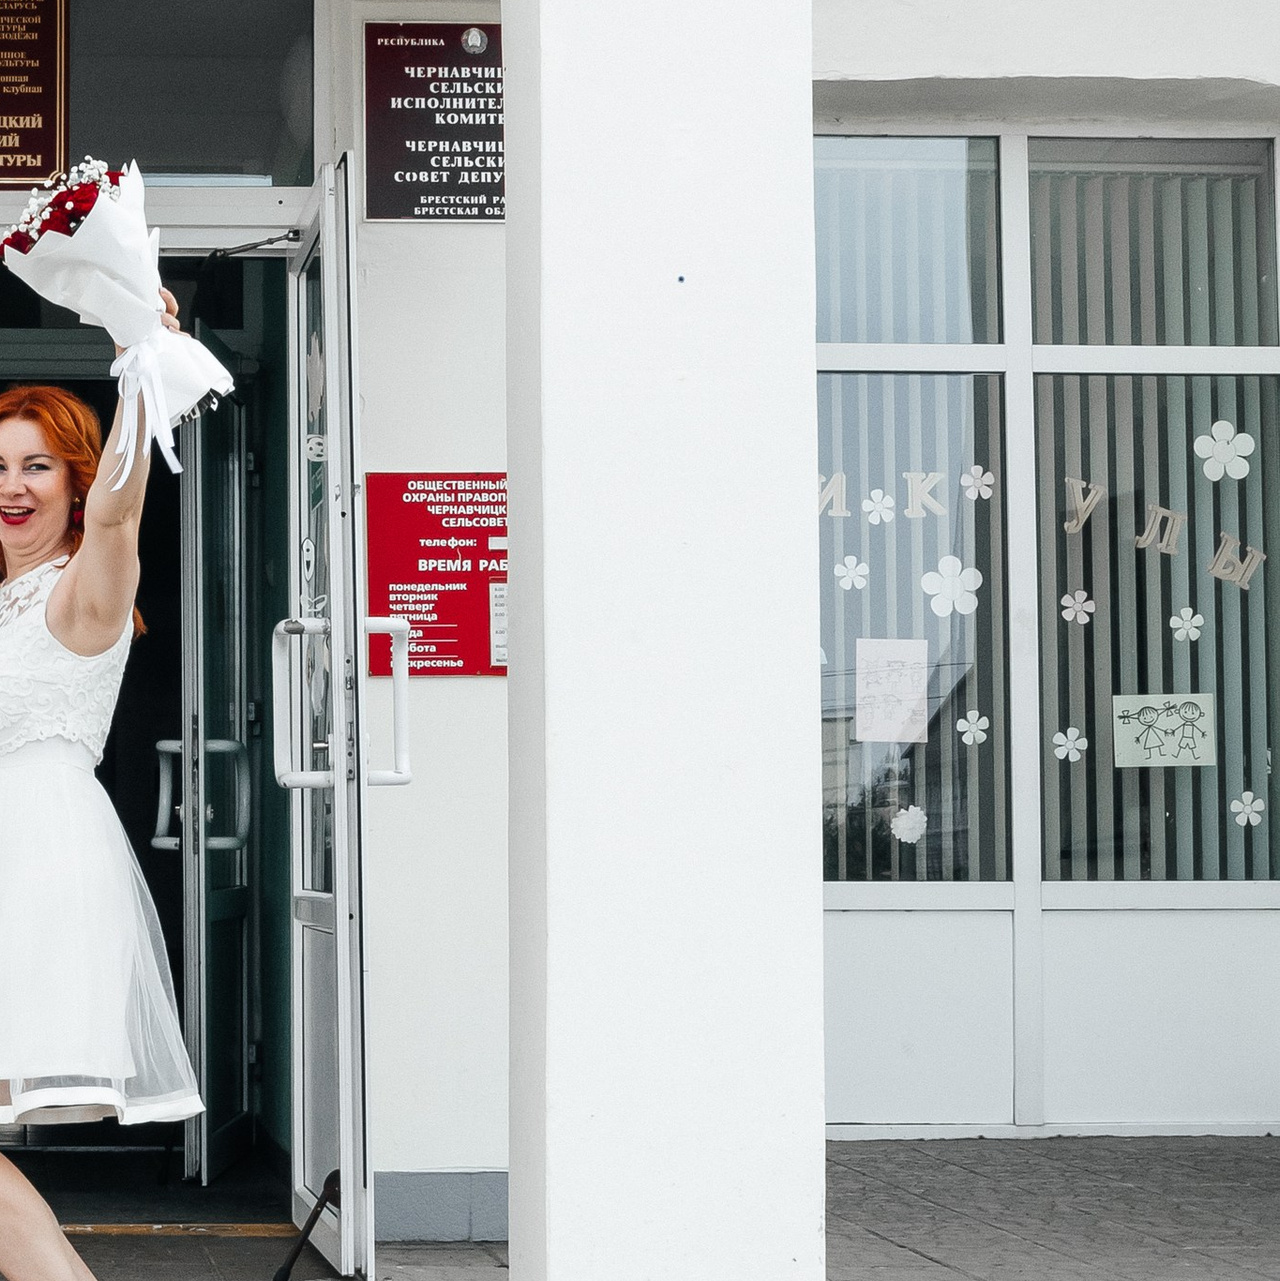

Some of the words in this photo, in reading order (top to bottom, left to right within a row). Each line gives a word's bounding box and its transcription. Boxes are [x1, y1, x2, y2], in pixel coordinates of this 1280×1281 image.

[377, 38, 445, 46] РЕСПУБЛИКА
[3, 84, 43, 95] клубная
[435, 113, 505, 125] КОМИТЕ
[394, 171, 450, 183] СОВЕТ
[420, 194, 487, 204] БРЕСТСКИЙ
[414, 207, 479, 216] БРЕСТСКАЯ
[407, 479, 507, 491] ОБЩЕСТВЕННЫЙ
[402, 492, 455, 503] ОХРАНЫ
[457, 492, 506, 502] ПРАВОП
[427, 505, 506, 516] ЧЕРНАВЧИЦК
[441, 517, 507, 527] СЕЛЬСОВЕТ
[419, 536, 477, 549] телефон:
[418, 559, 472, 571] ВРЕМЯ
[478, 559, 508, 571] РАБ
[388, 583, 467, 592] понедельник
[388, 593, 439, 603] вторник
[389, 603, 435, 613] четверг
